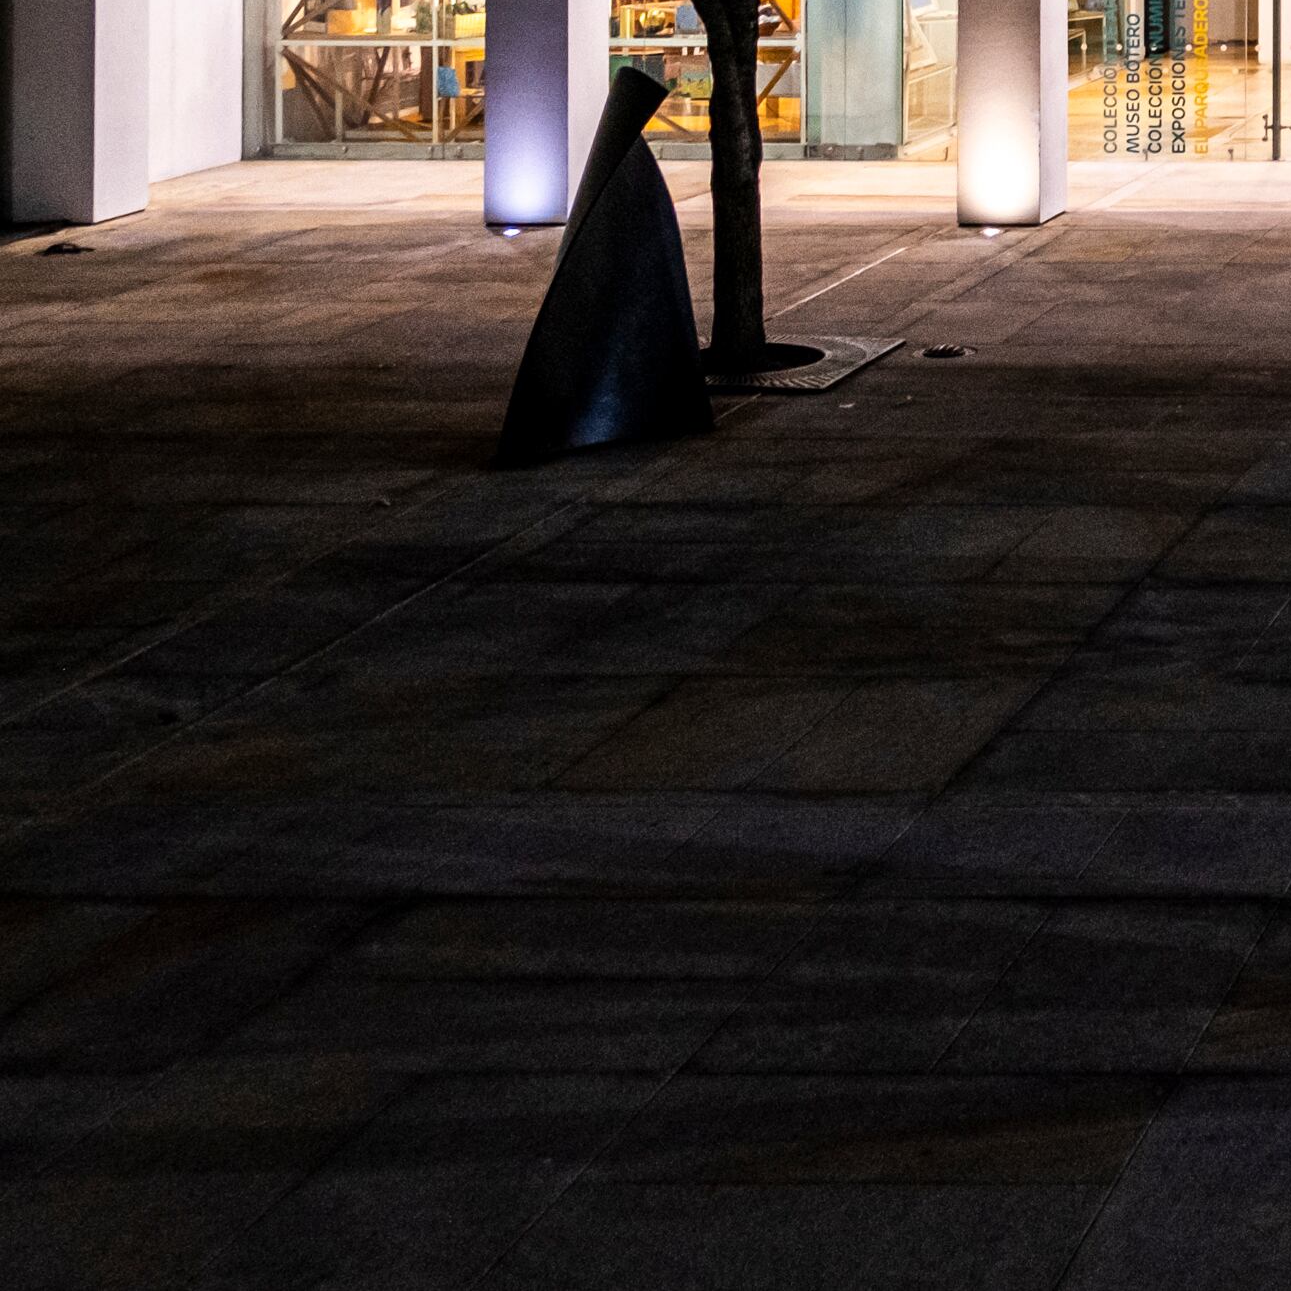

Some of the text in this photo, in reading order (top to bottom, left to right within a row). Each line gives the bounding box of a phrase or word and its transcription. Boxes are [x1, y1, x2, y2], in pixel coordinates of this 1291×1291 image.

[1126, 14, 1140, 154] MUSEO BOTERO
[1145, 54, 1163, 154] COLECCIÓN
[1172, 27, 1186, 154] EXPOSICIONES
